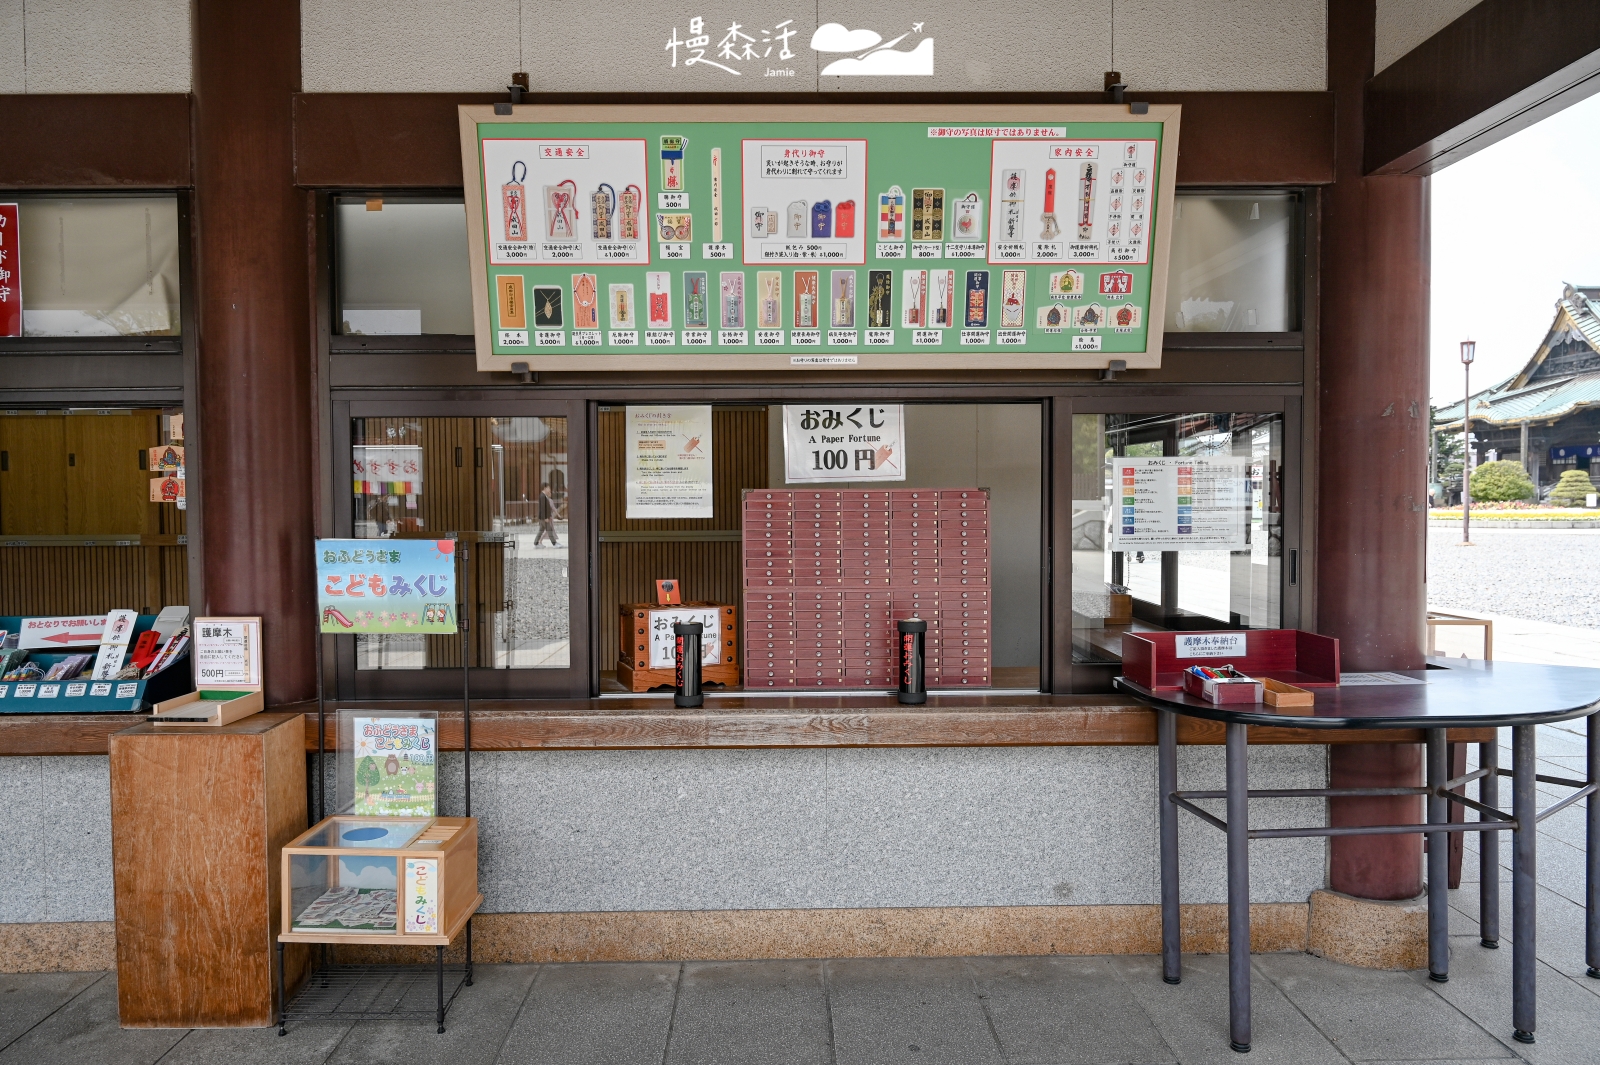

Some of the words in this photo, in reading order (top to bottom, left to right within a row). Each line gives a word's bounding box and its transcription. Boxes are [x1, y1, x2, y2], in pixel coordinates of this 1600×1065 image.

[544, 148, 585, 157] 交通安全
[784, 149, 825, 158] 身代り御守
[1055, 148, 1093, 157] 家内安全
[800, 408, 885, 430] おみくじ
[822, 435, 844, 444] Paper
[848, 434, 881, 442] Fortune
[812, 449, 848, 470] 100
[855, 449, 875, 471] 円
[322, 549, 402, 564] おふどうさま
[323, 574, 448, 598] こどもみくじ
[202, 628, 232, 637] 護摩木
[1184, 636, 1238, 646] 護摩木奉納台
[202, 669, 224, 677] 500円
[363, 724, 418, 737] おふどうさま
[375, 737, 430, 750] こどもみくじ
[414, 865, 428, 925] こどもみくじ
